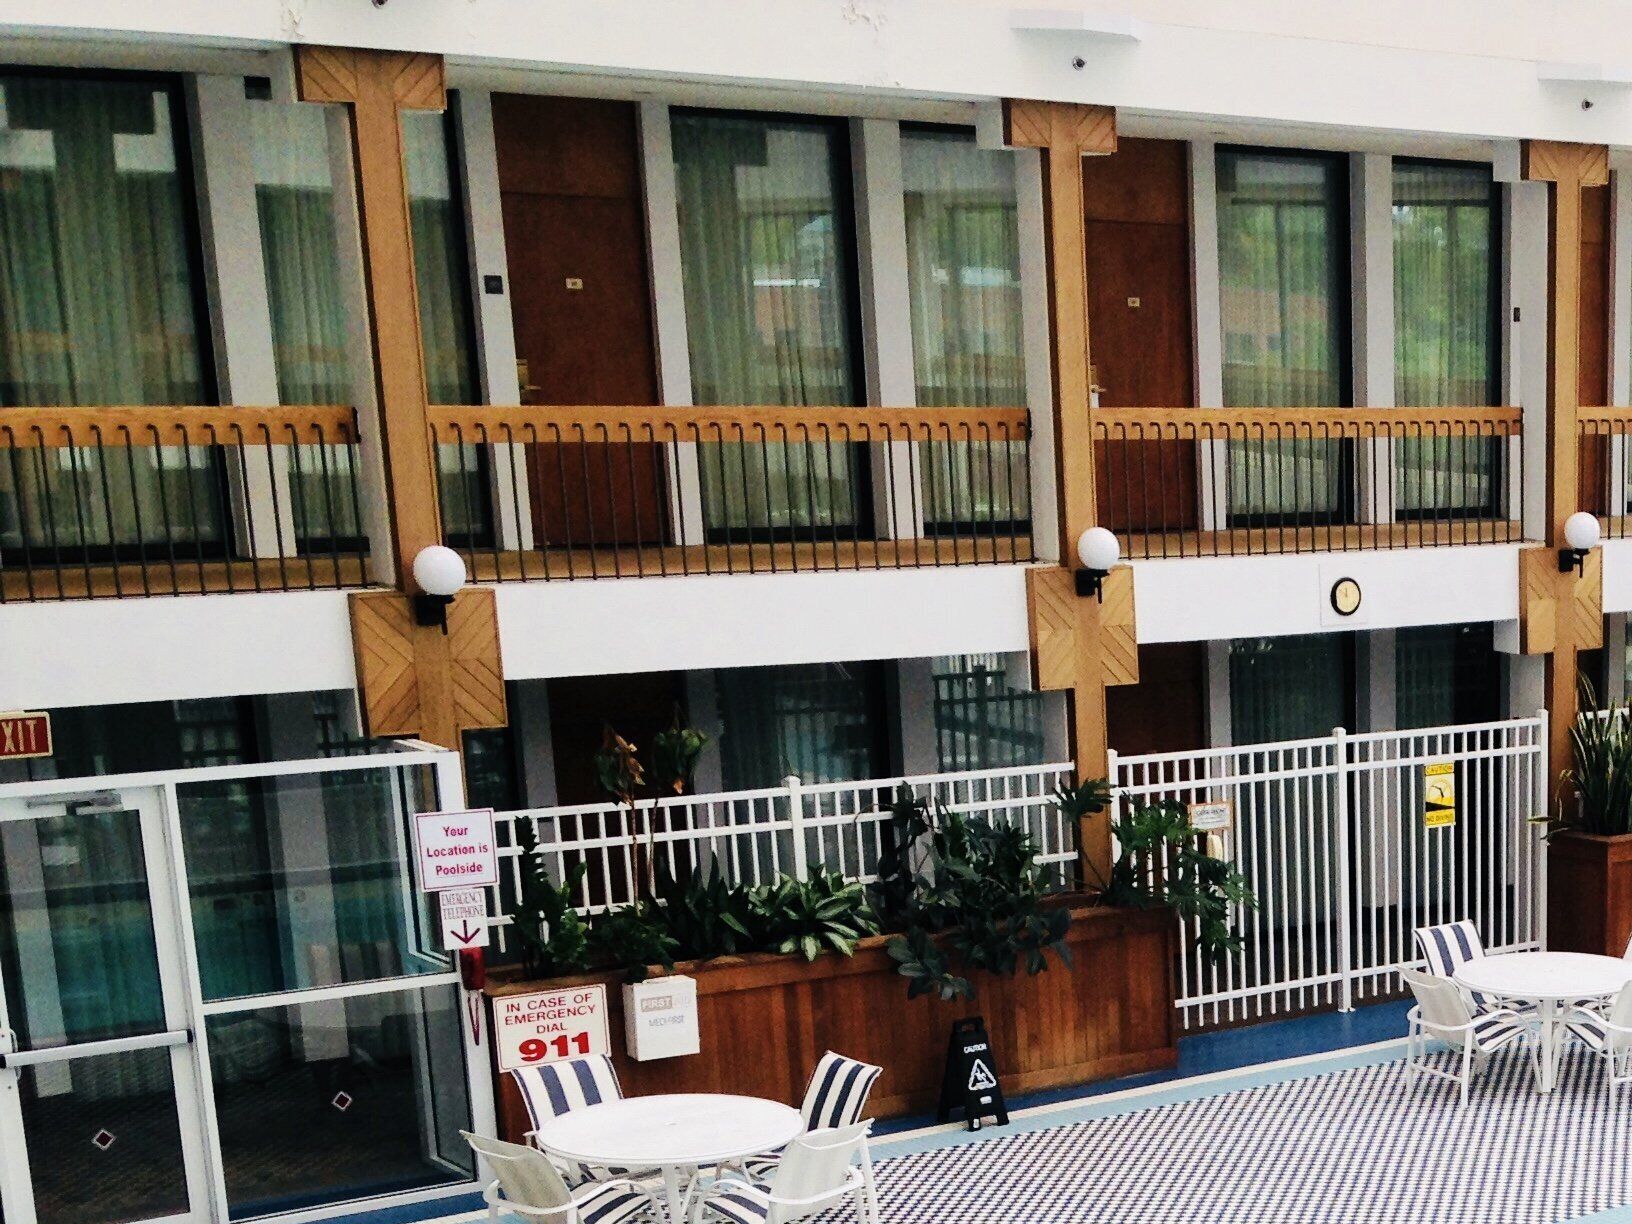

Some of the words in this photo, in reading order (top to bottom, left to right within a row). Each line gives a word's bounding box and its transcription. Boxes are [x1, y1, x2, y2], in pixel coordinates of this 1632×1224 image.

[1, 720, 37, 753] XIT
[443, 826, 468, 837] Your
[426, 845, 475, 858] Location
[479, 843, 488, 853] is
[436, 861, 483, 876] Poolside
[441, 892, 482, 906] EMERGENCY
[443, 905, 484, 920] TELEPHONE
[506, 1003, 521, 1013] IN
[527, 996, 567, 1010] CASE
[574, 993, 593, 1004] OF
[642, 997, 671, 1010] FIRST
[505, 1004, 596, 1026] EMERGENCY
[536, 1022, 568, 1034] DIAL
[518, 1032, 590, 1062] 911
